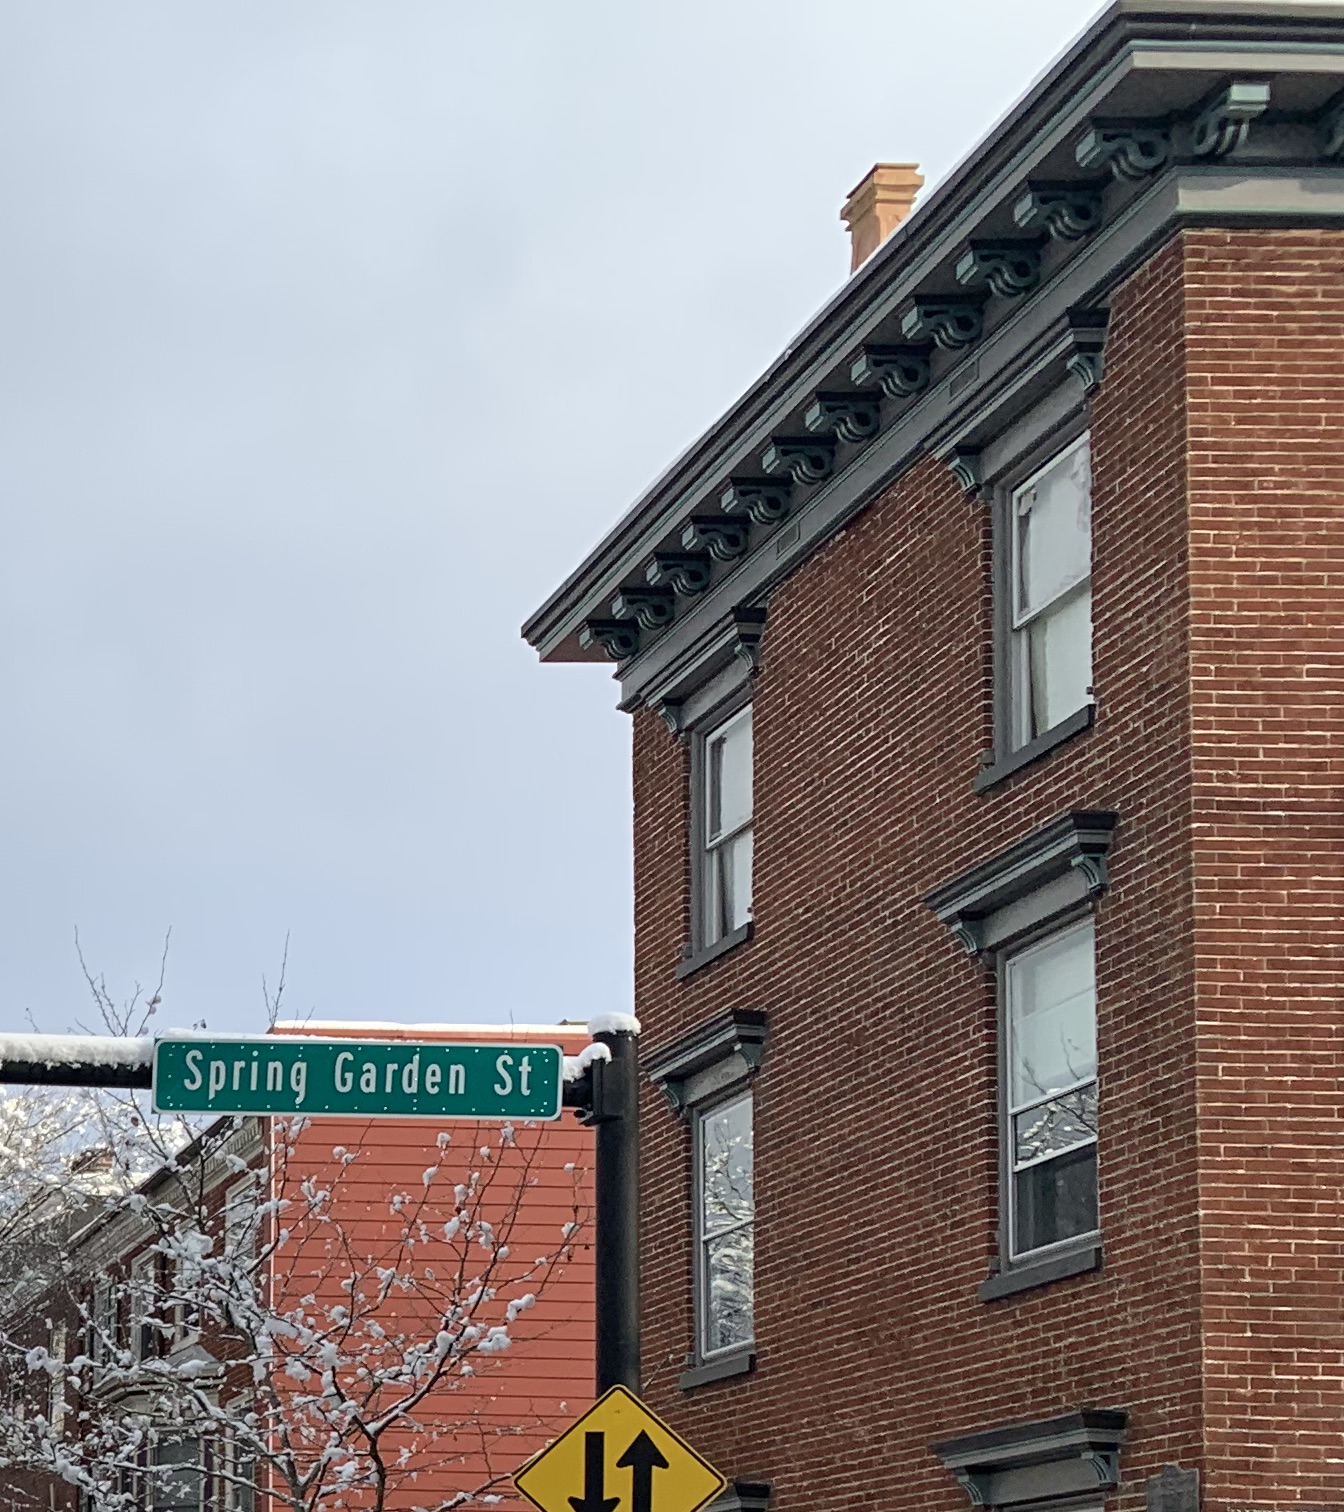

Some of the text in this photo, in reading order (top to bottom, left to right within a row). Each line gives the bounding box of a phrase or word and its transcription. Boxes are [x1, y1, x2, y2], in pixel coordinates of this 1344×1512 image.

[183, 1049, 532, 1105] Spring Garden St
